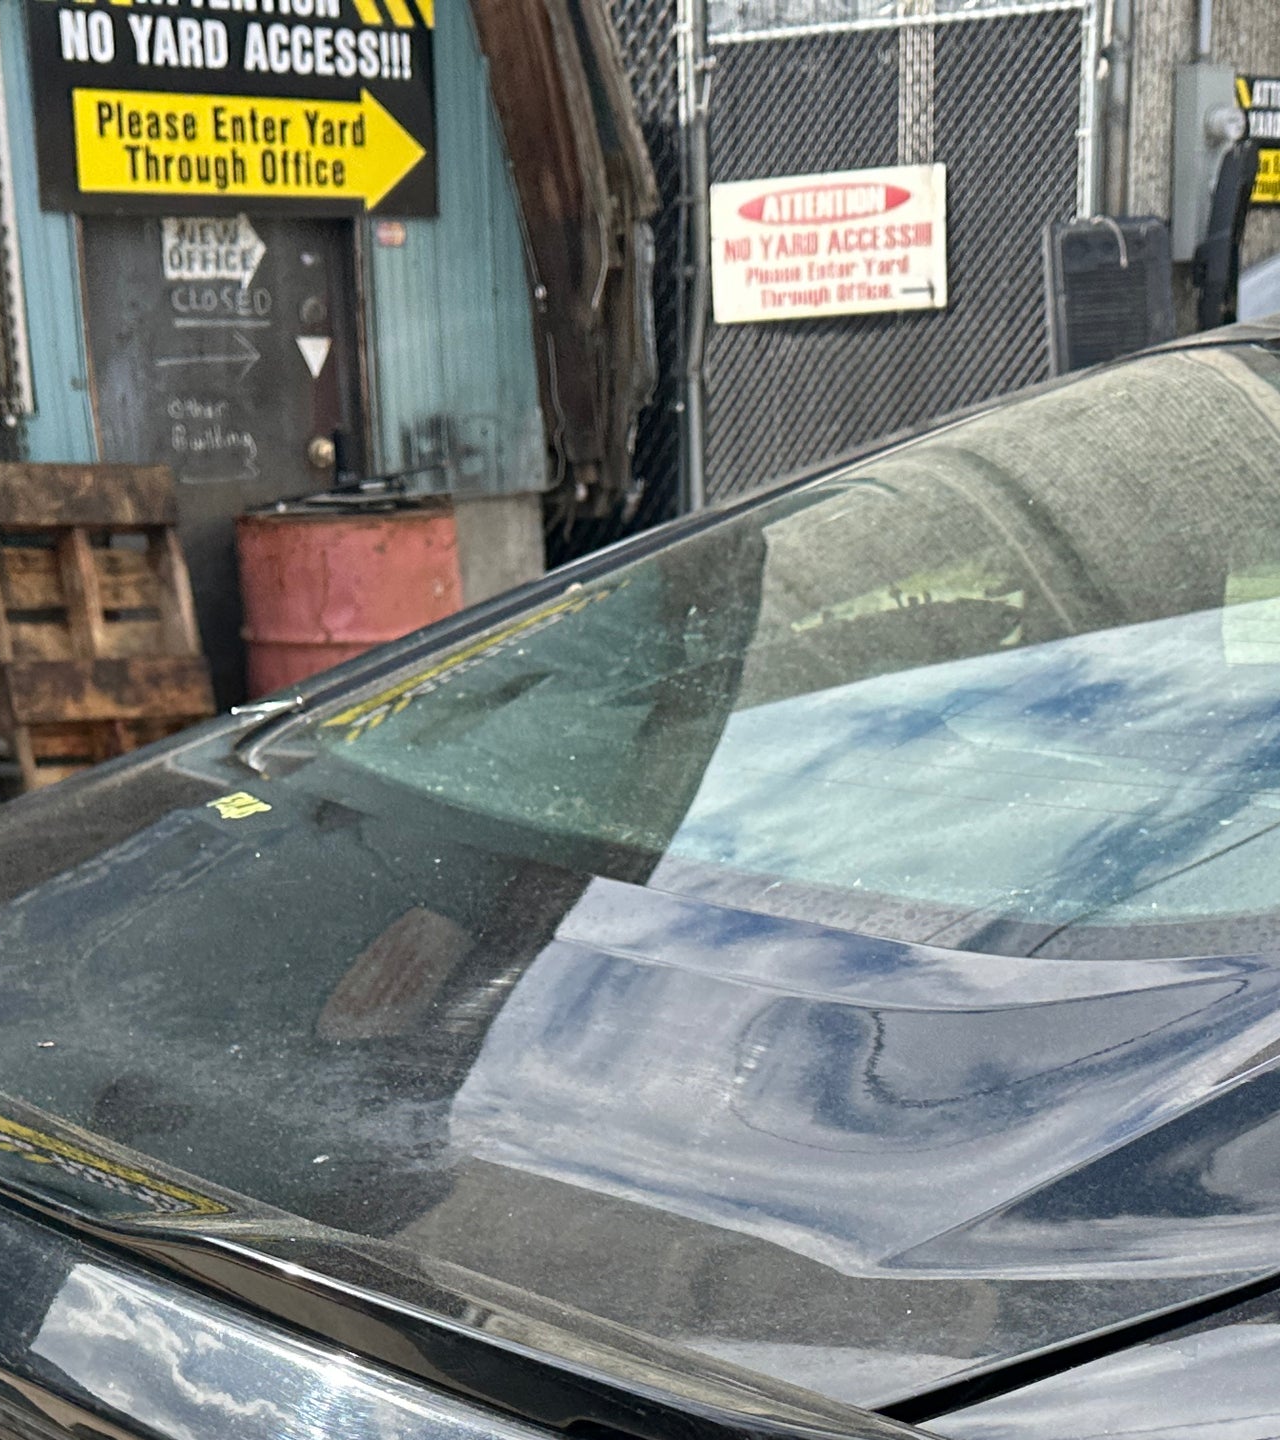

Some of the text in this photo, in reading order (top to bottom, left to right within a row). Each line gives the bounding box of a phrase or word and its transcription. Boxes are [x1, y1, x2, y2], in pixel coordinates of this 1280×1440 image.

[59, 9, 413, 81] NO YARD ACCESS!!!
[97, 101, 366, 147] Please Enter Yard
[124, 145, 347, 190] Through Office
[169, 246, 251, 273] OFFICE
[724, 237, 752, 264] NO
[760, 231, 819, 261] YARD
[745, 254, 911, 288] Please Enter Yard
[170, 286, 272, 317] CLOSED
[760, 288, 832, 310] Through
